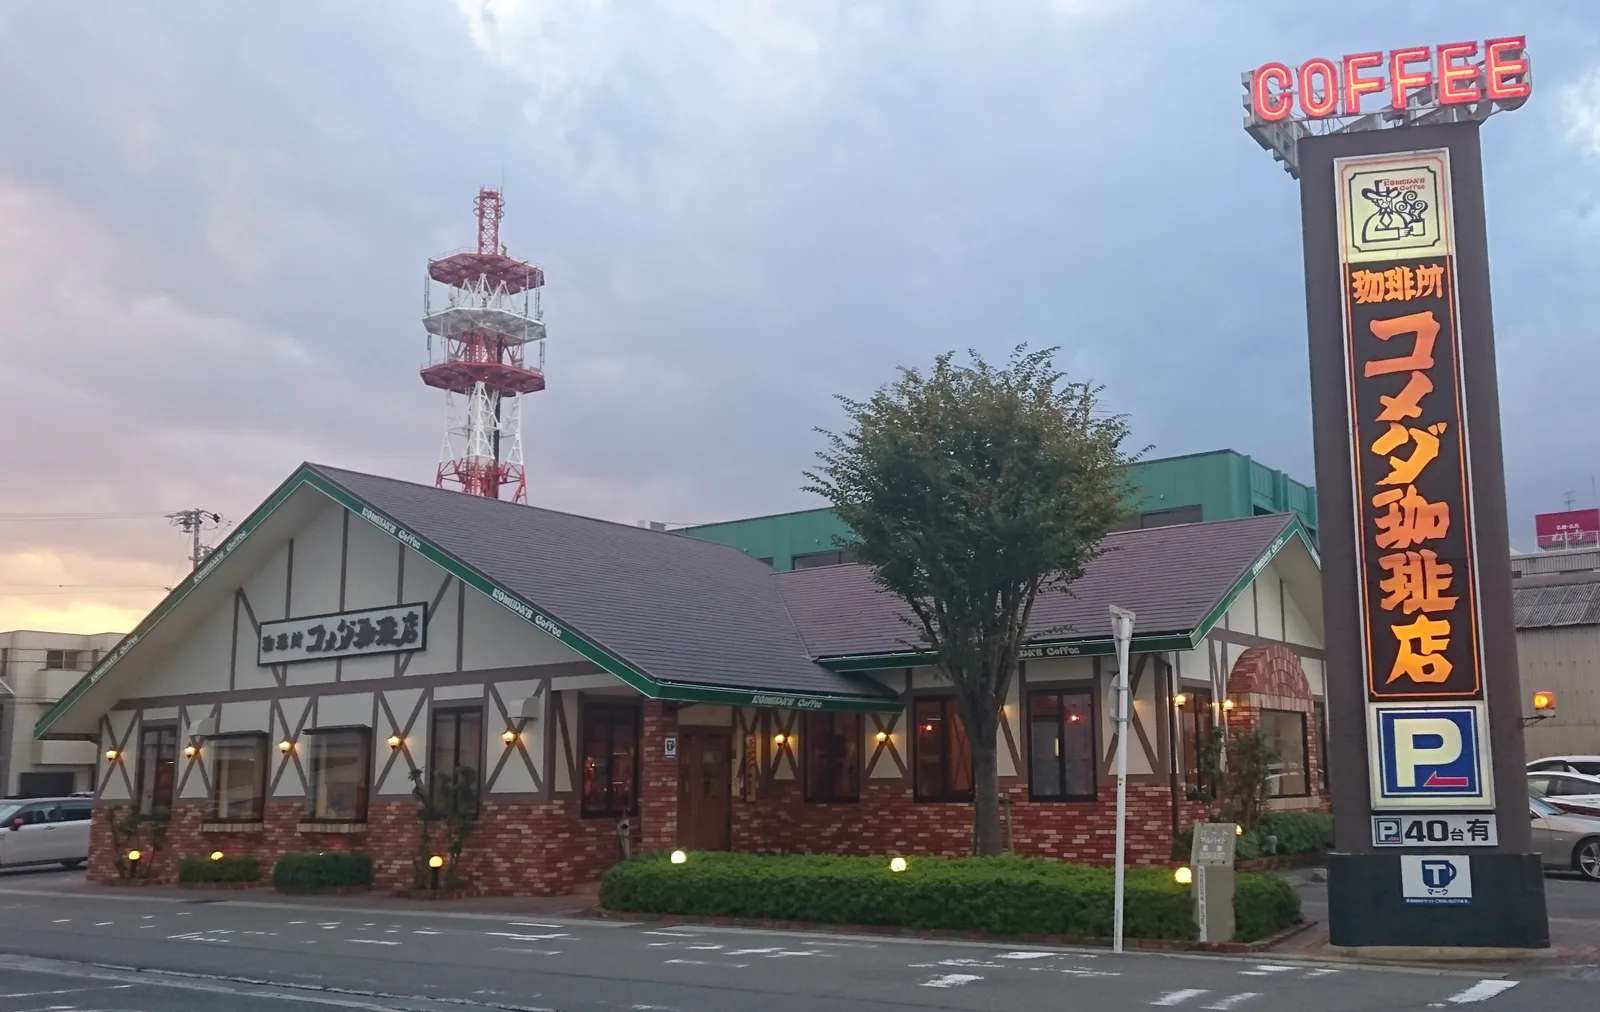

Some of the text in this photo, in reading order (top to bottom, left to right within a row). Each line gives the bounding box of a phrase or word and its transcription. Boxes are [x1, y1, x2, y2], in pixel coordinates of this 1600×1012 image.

[1254, 35, 1529, 121] COFFEE
[1352, 264, 1445, 304] 珈琲所
[1364, 310, 1460, 684] コメダ珈琲店
[398, 530, 421, 550] Coffee
[535, 614, 562, 639] Coffee
[1046, 646, 1080, 656] Coffee
[797, 698, 823, 709] Coffee
[1393, 718, 1463, 788] P
[1379, 821, 1398, 841] P
[1425, 864, 1446, 884] T
[1427, 888, 1448, 896] マーク
